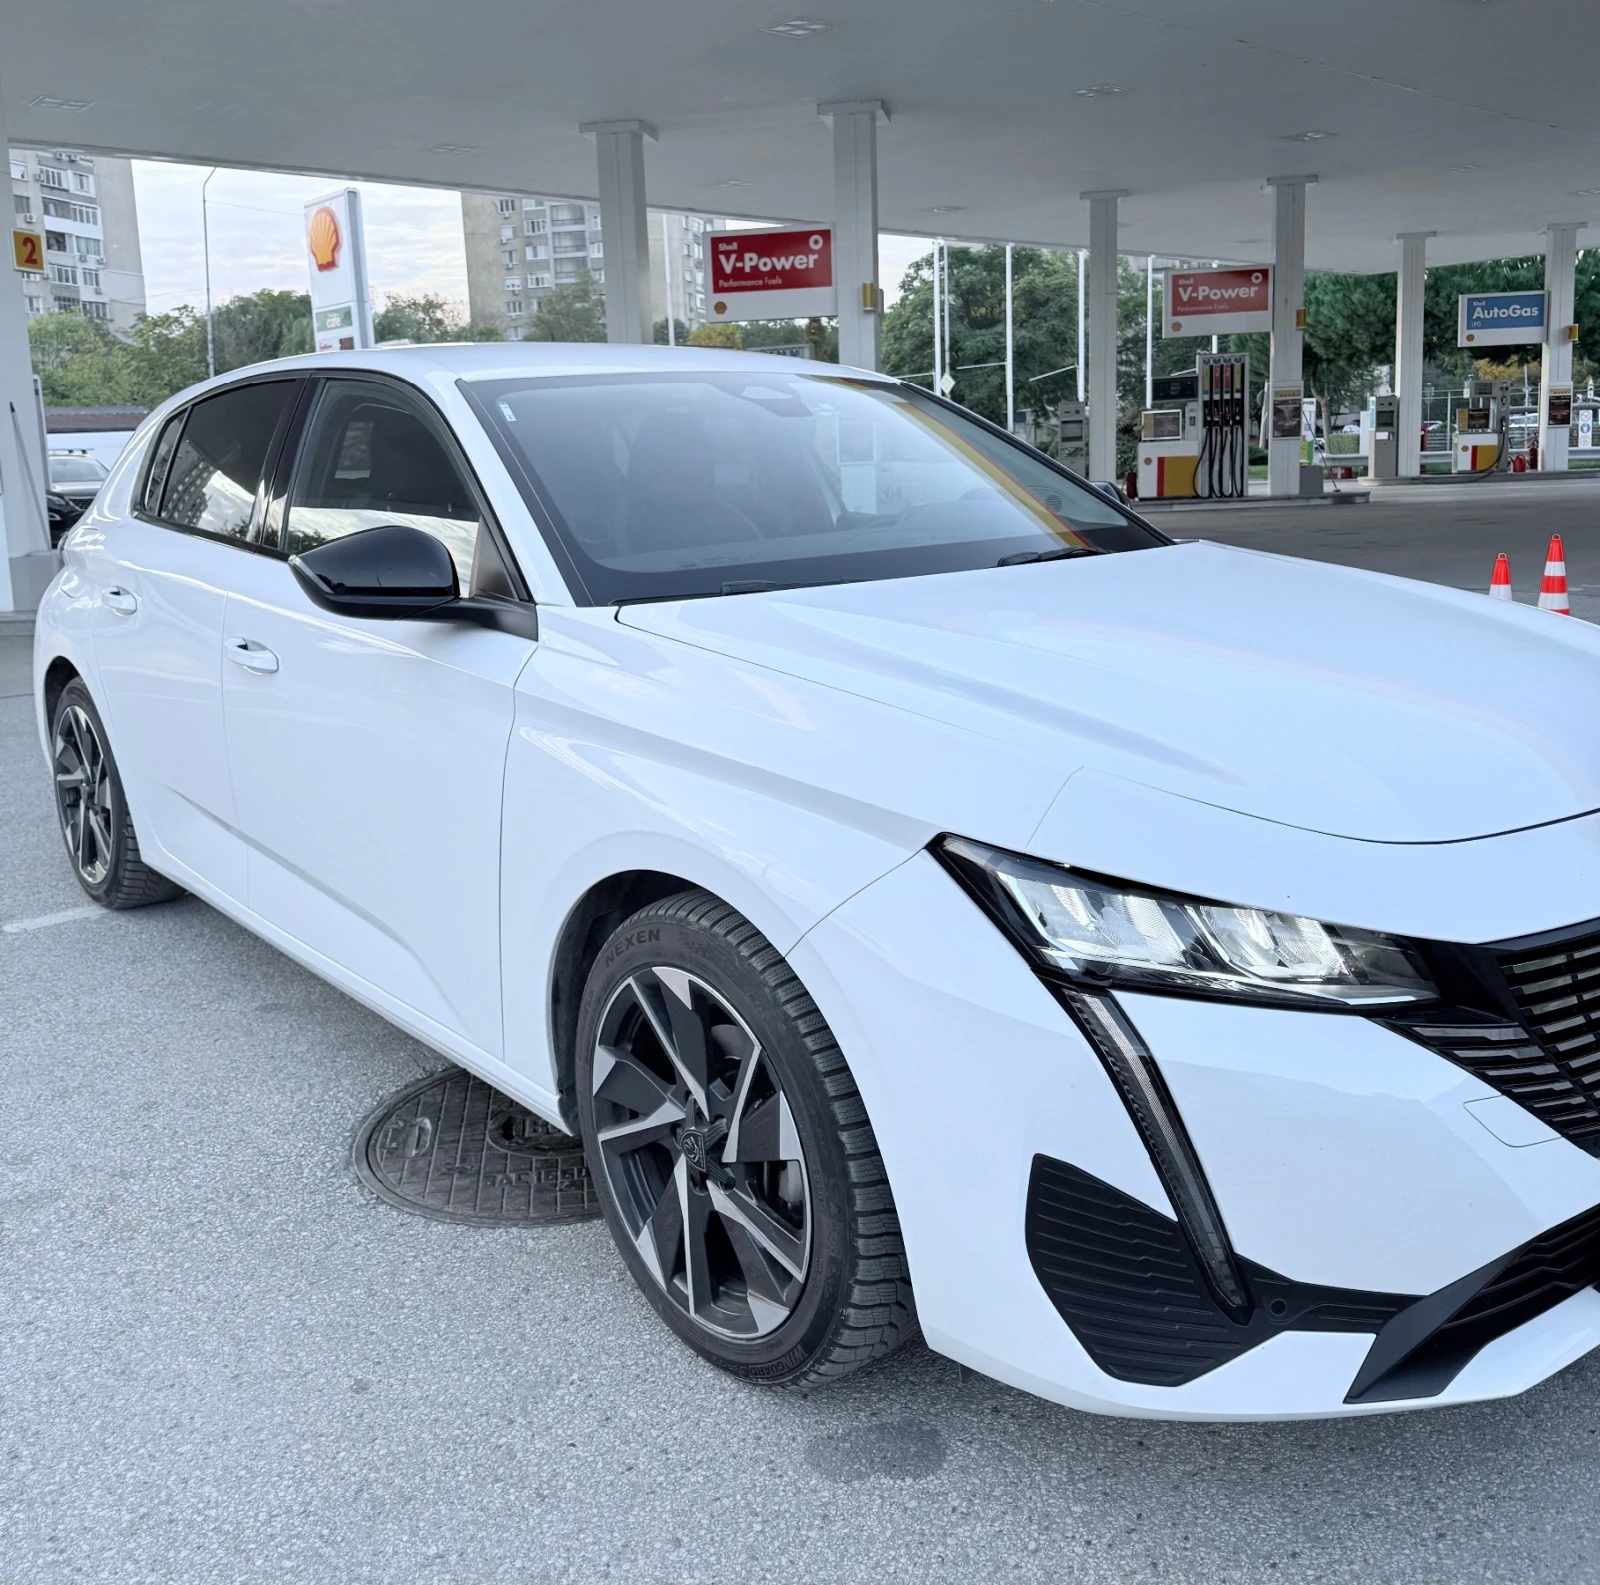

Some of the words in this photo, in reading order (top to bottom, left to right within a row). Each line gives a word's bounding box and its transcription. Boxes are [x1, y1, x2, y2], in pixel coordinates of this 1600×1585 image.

[22, 236, 38, 265] 2
[718, 242, 738, 251] Shell
[718, 252, 819, 275] V-Power
[719, 279, 763, 288] Performance
[764, 276, 782, 285] Fuels
[1178, 286, 1258, 302] V-Power
[1472, 305, 1539, 320] AutoGas
[605, 928, 661, 968] NEXEN
[748, 1343, 809, 1377] WINGUARD
